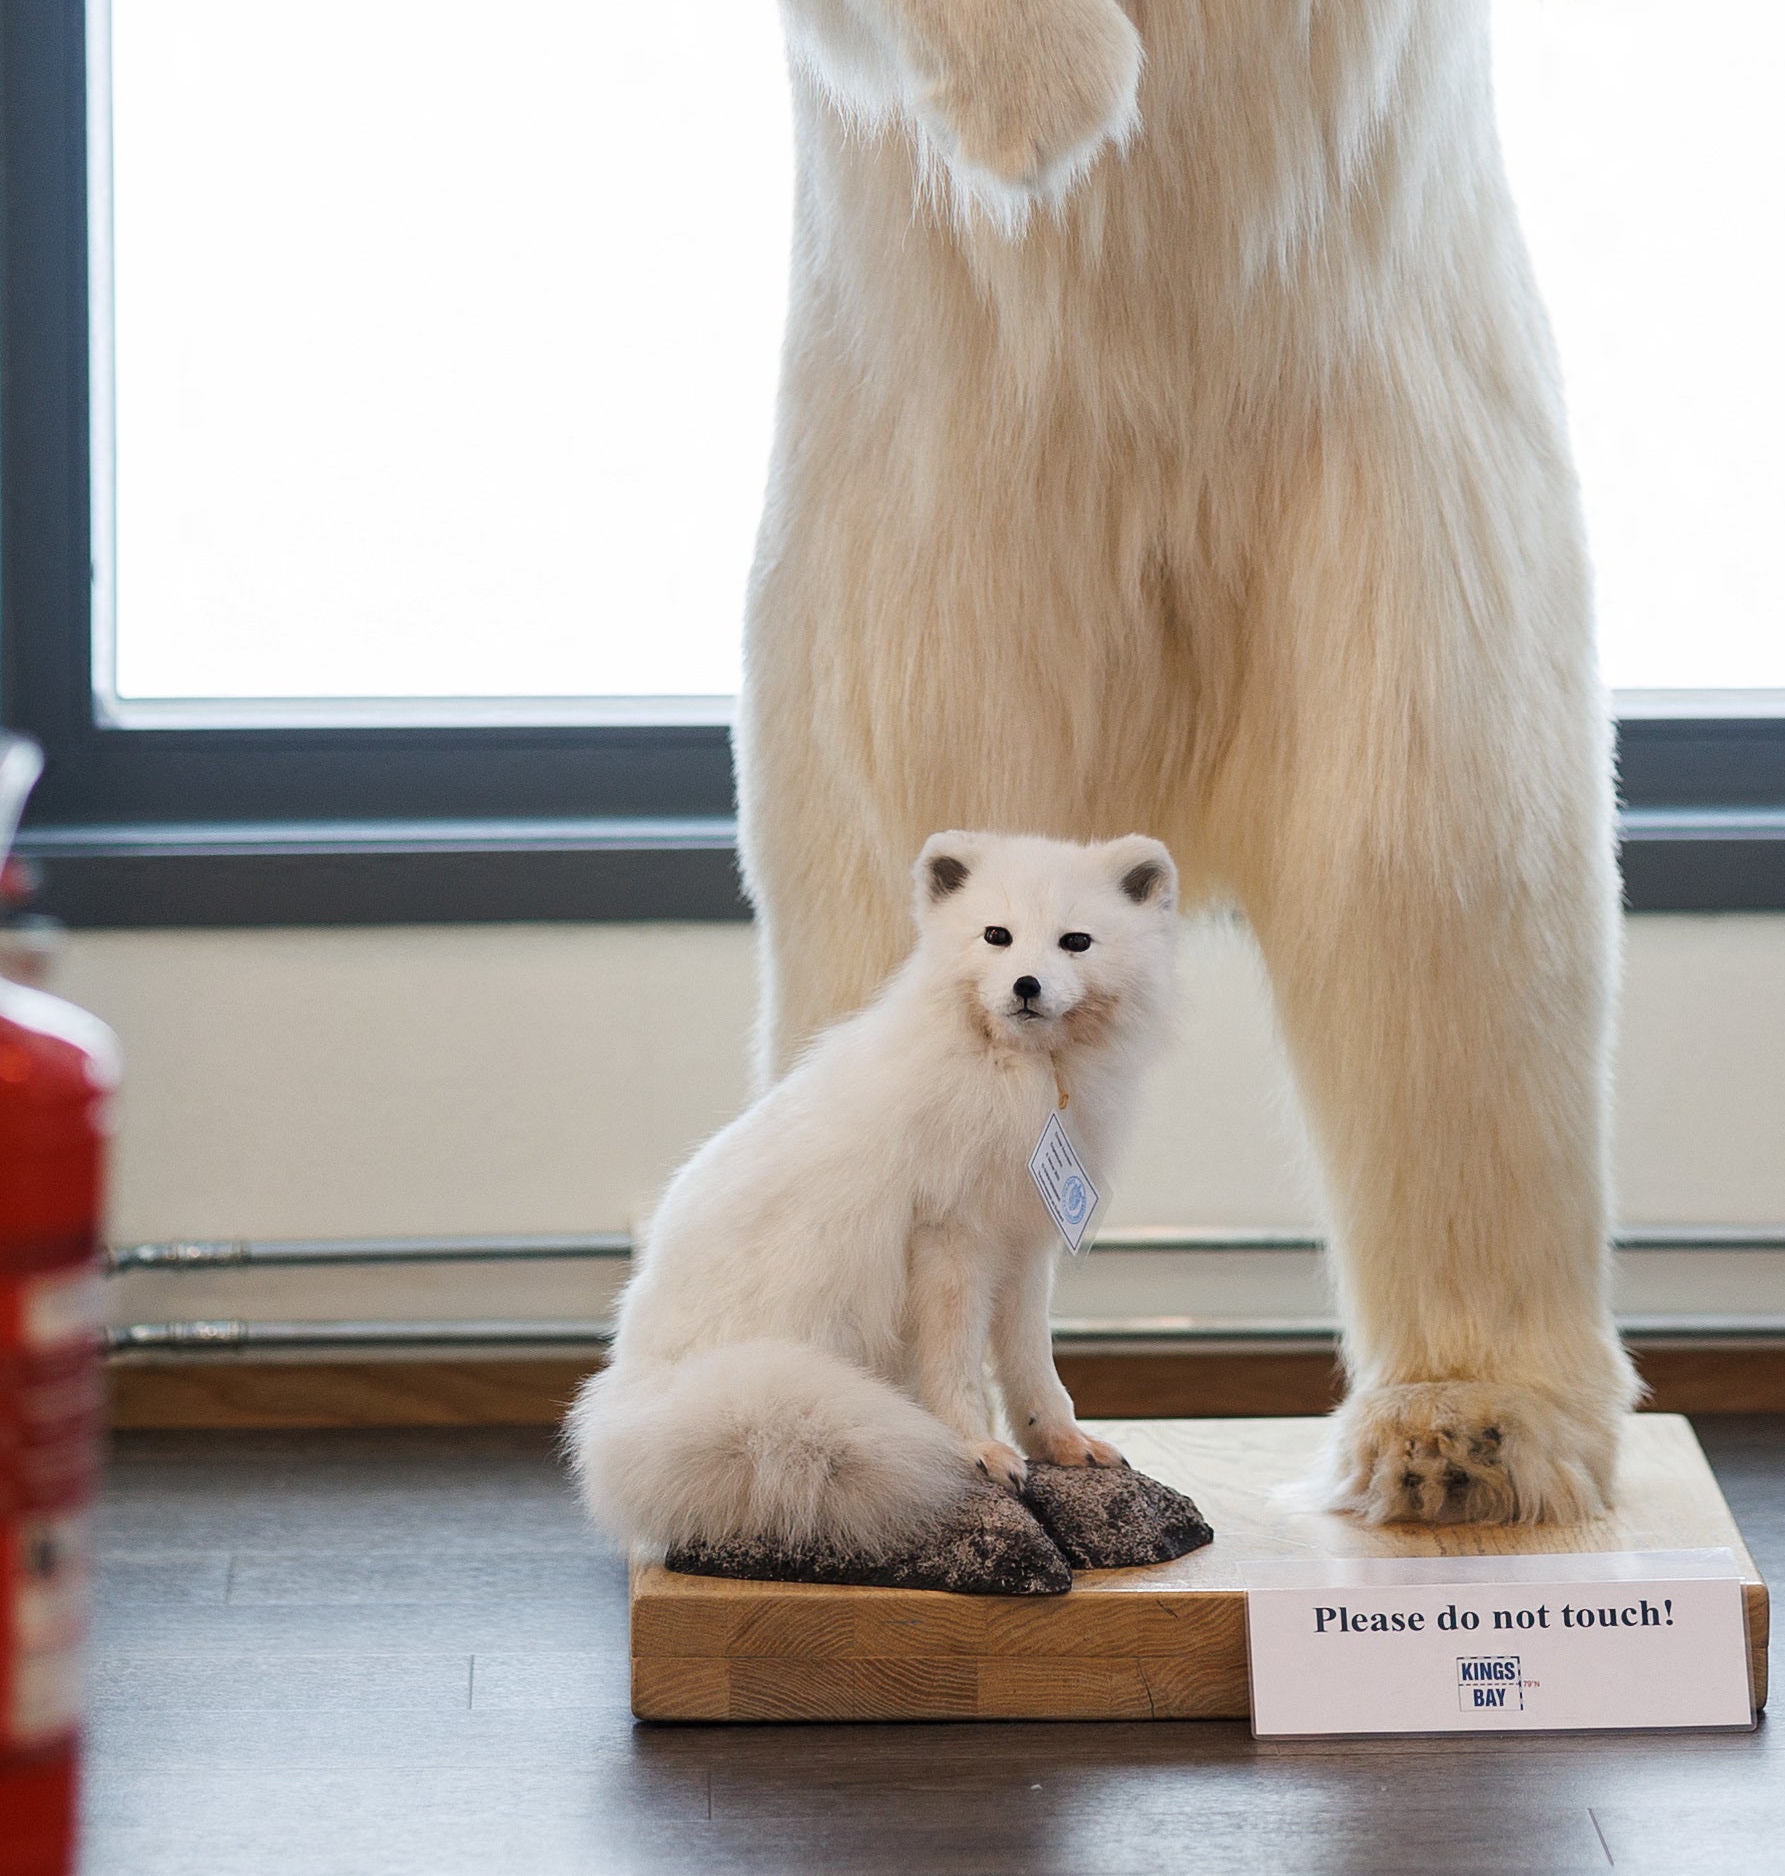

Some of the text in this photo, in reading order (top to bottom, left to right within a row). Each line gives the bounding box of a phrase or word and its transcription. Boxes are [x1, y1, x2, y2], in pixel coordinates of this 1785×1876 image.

[1313, 1600, 1673, 1632] Please do not touch!
[1462, 1662, 1515, 1680] KINGS
[1473, 1689, 1505, 1706] BAY
